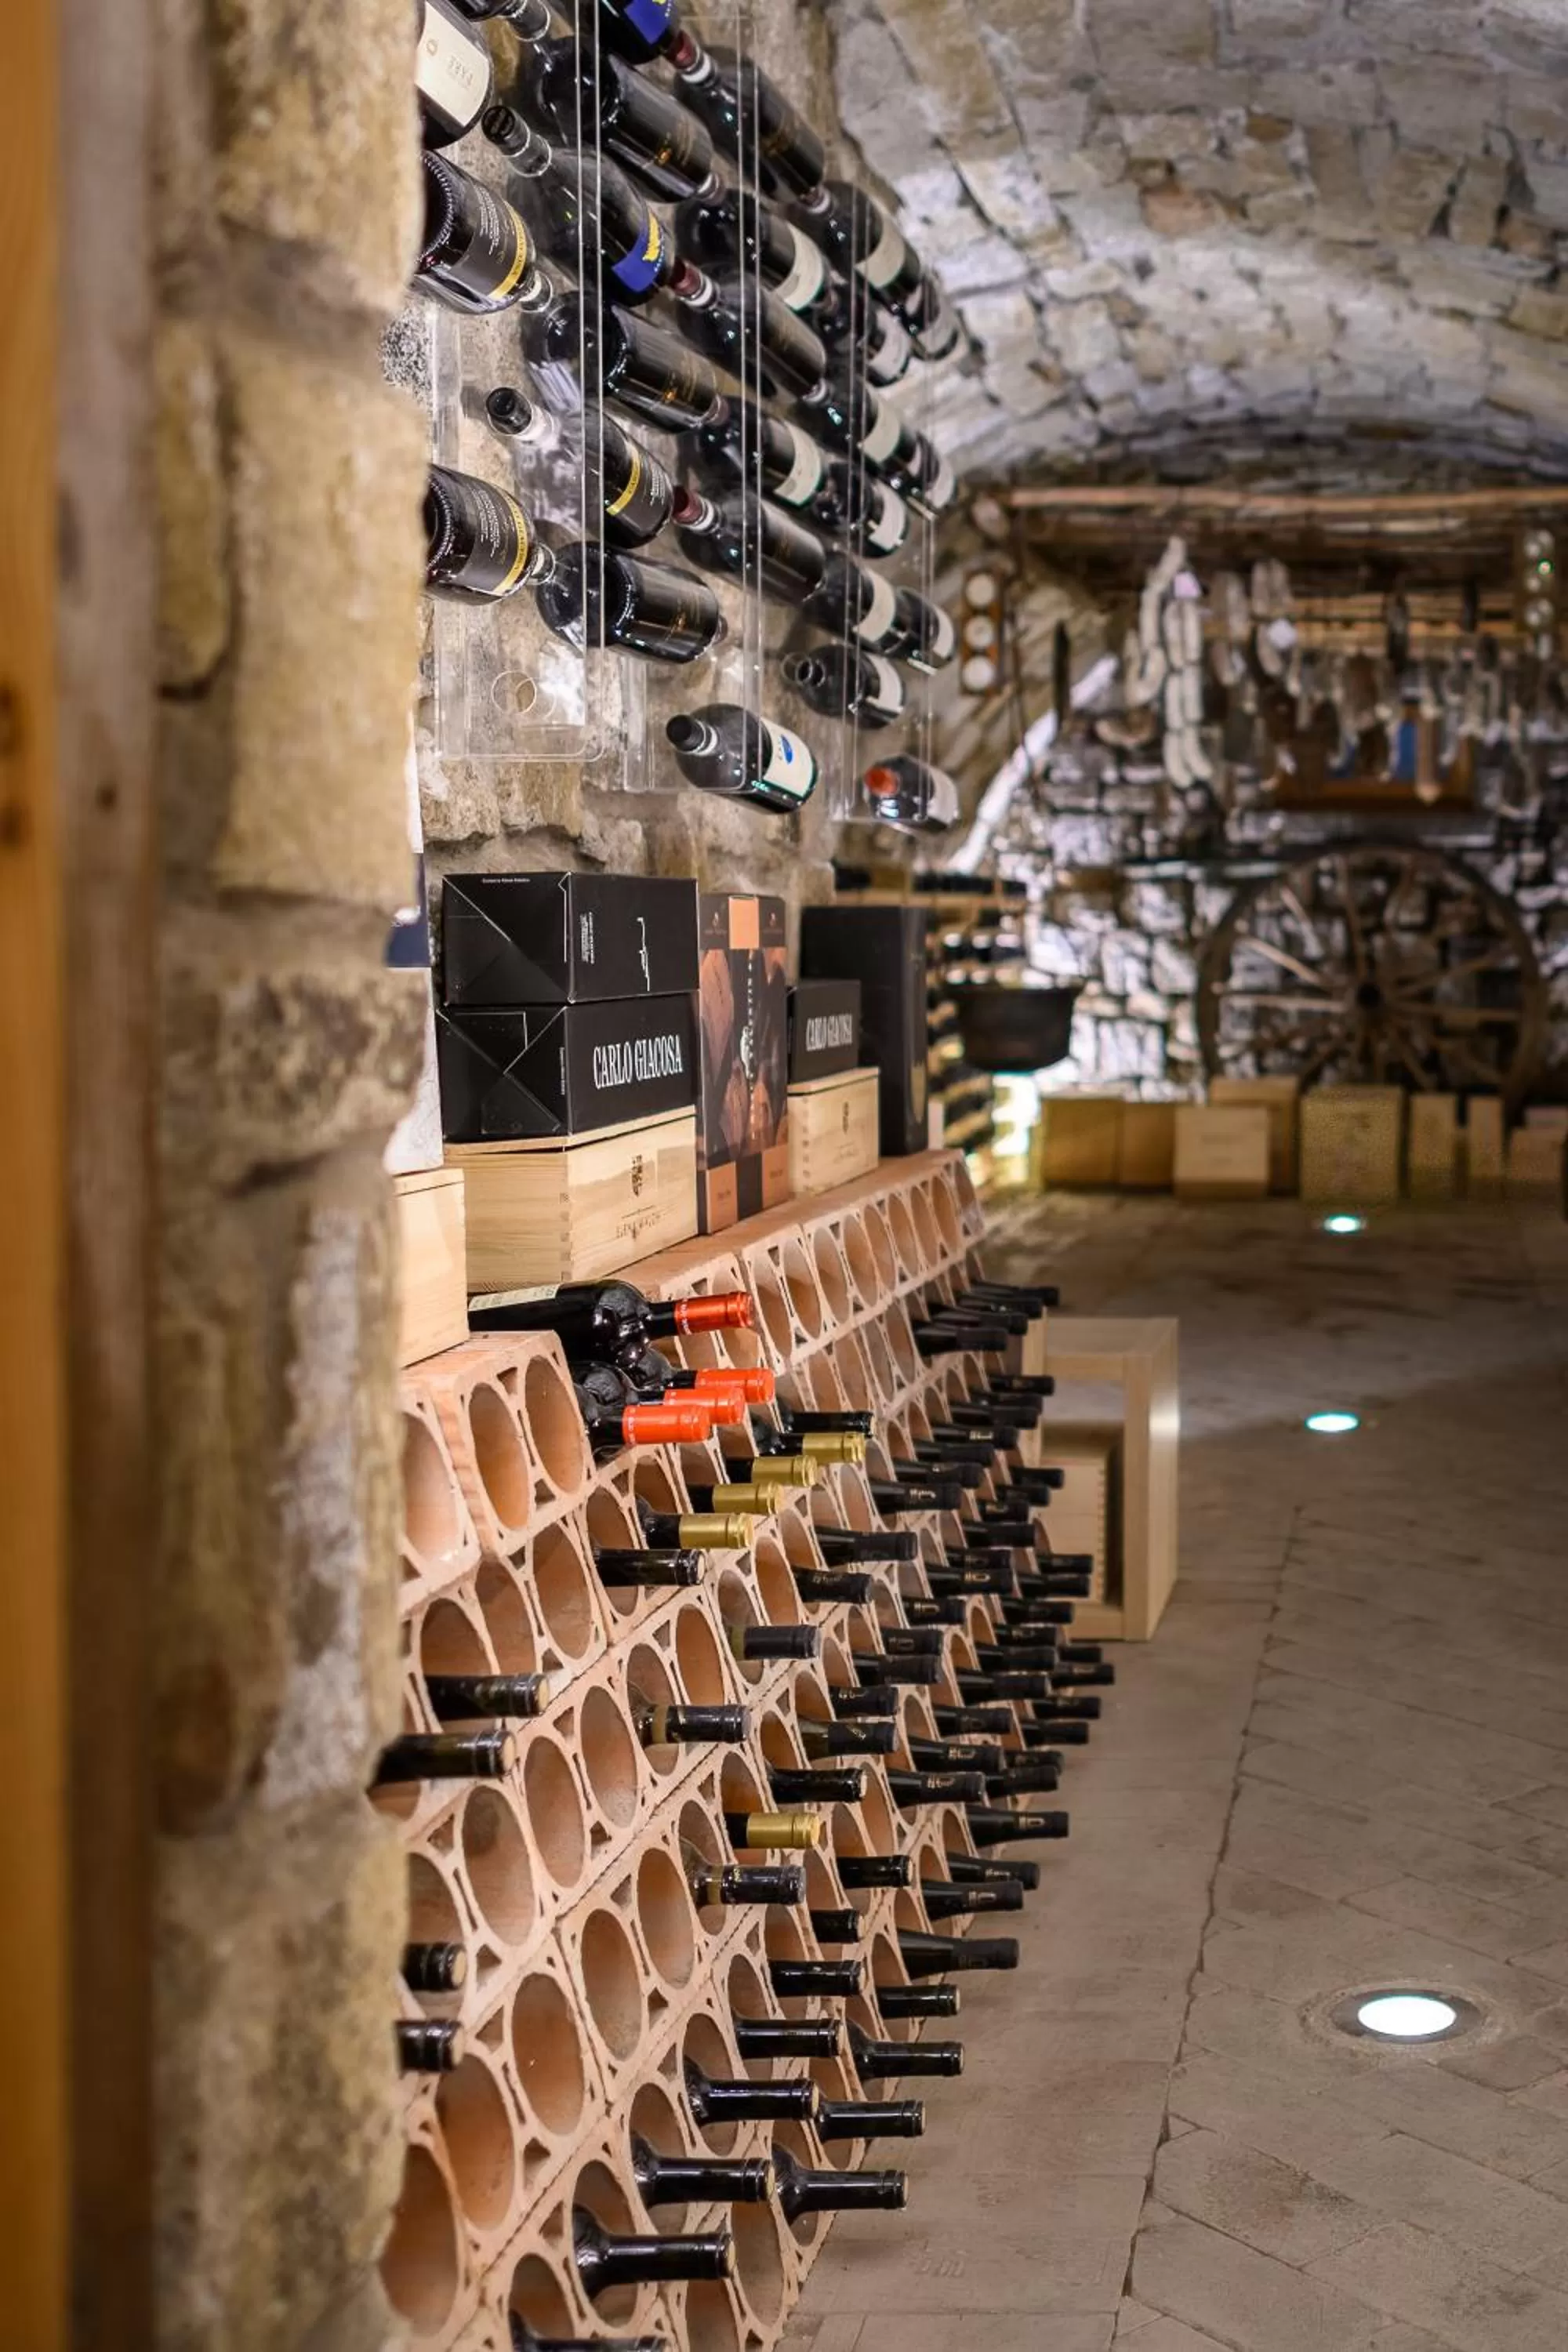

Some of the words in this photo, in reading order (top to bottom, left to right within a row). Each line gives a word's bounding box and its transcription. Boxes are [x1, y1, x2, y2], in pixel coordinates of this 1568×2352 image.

[806, 1015, 827, 1051] CARLO
[827, 1013, 852, 1047] GIACOSA
[593, 1040, 633, 1090] CARLO
[634, 1034, 683, 1081] GIACOSA
